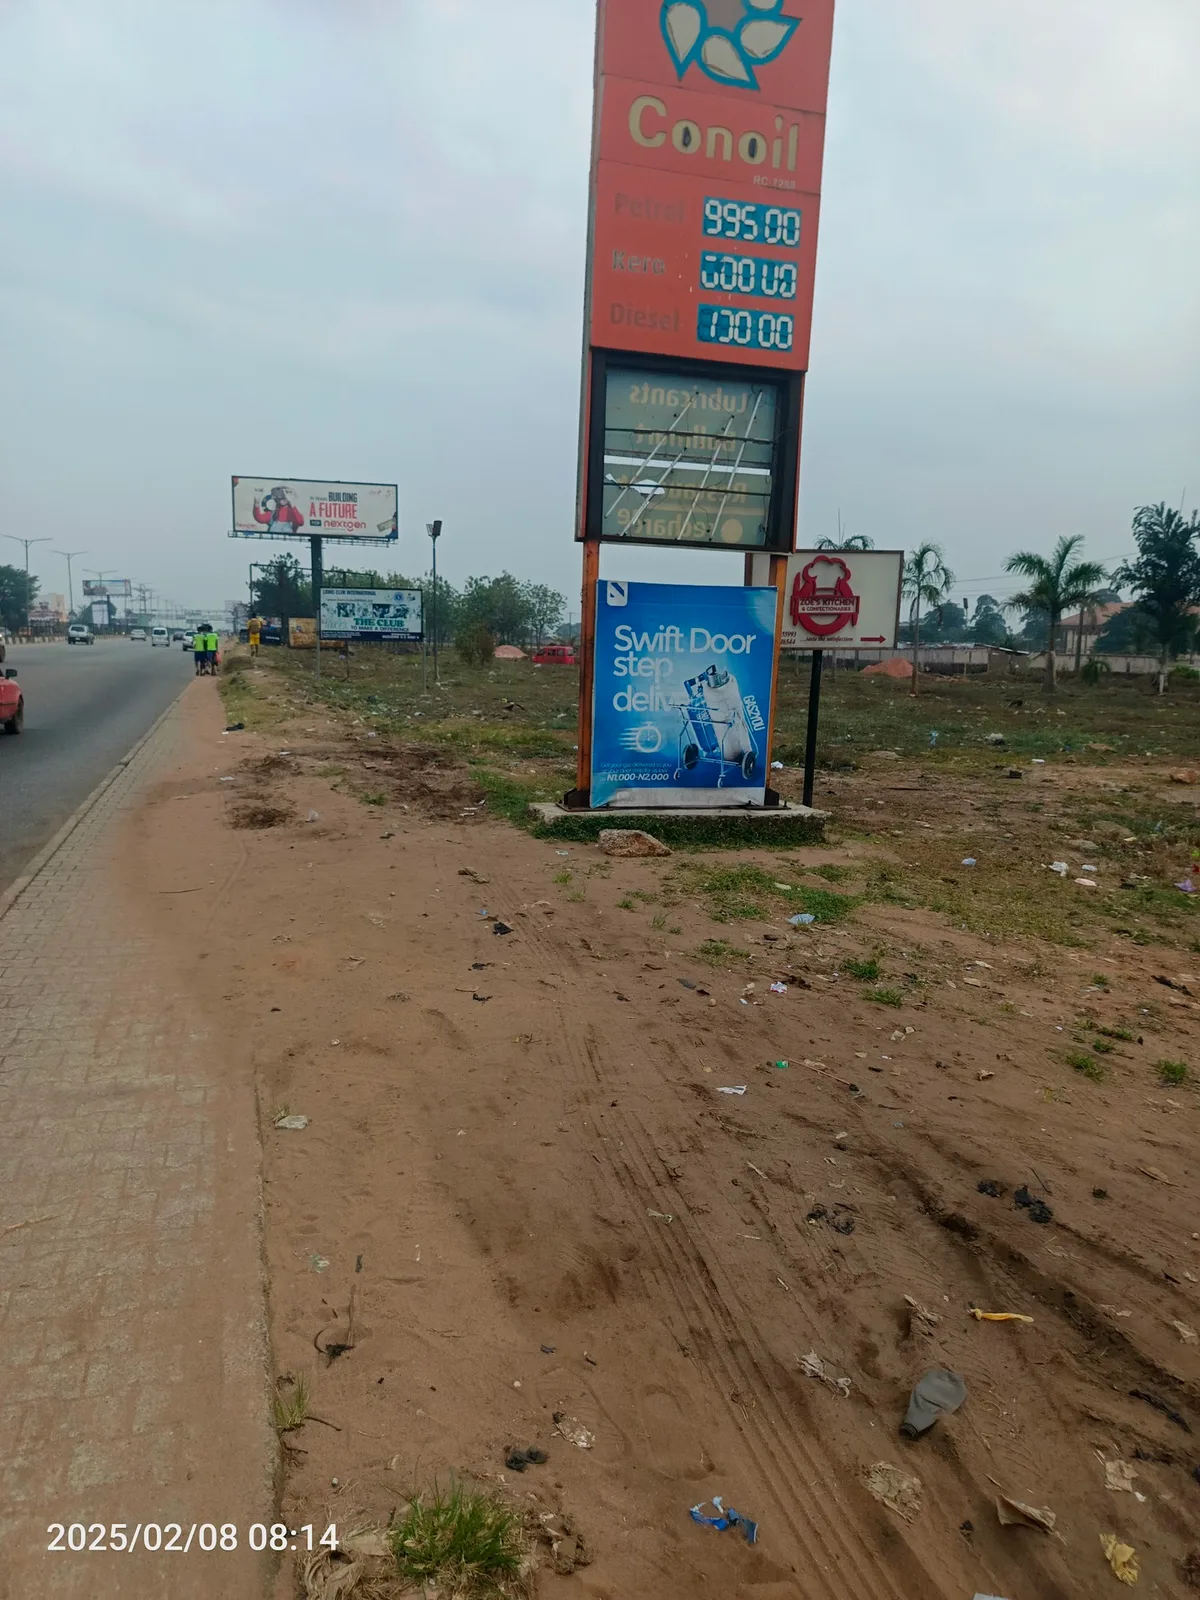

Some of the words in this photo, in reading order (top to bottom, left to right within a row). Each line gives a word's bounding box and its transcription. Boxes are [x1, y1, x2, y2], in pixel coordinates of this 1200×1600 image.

[628, 95, 801, 172] Conoil
[611, 249, 665, 275] Kero
[609, 302, 680, 333] Diesel
[309, 502, 316, 517] A
[319, 502, 358, 519] FUTURE
[328, 492, 357, 503] BUILDING
[323, 520, 367, 532] nextgen
[354, 618, 376, 626] THE
[377, 619, 404, 627] CLUB
[614, 625, 685, 653] Swift
[689, 627, 756, 655] Door
[613, 651, 674, 684] step
